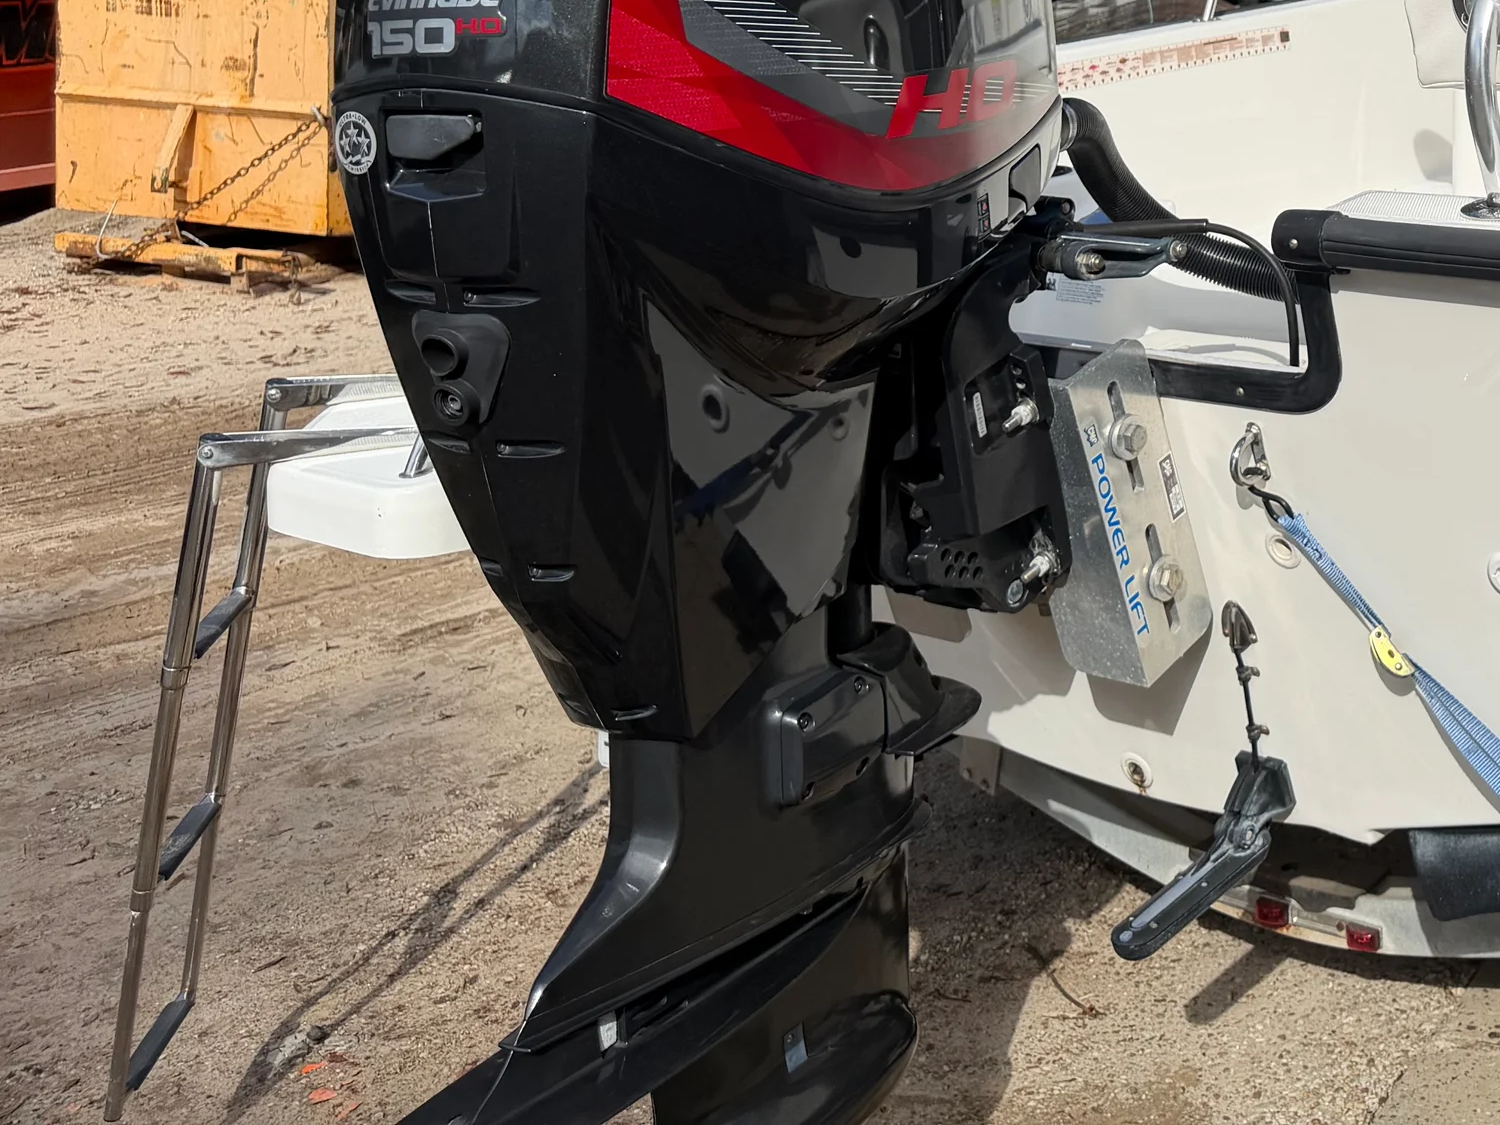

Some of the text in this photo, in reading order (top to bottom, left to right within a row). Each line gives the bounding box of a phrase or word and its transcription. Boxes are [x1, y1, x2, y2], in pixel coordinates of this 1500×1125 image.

[367, 17, 456, 56] 150
[1091, 452, 1150, 636] POWER LIFT
